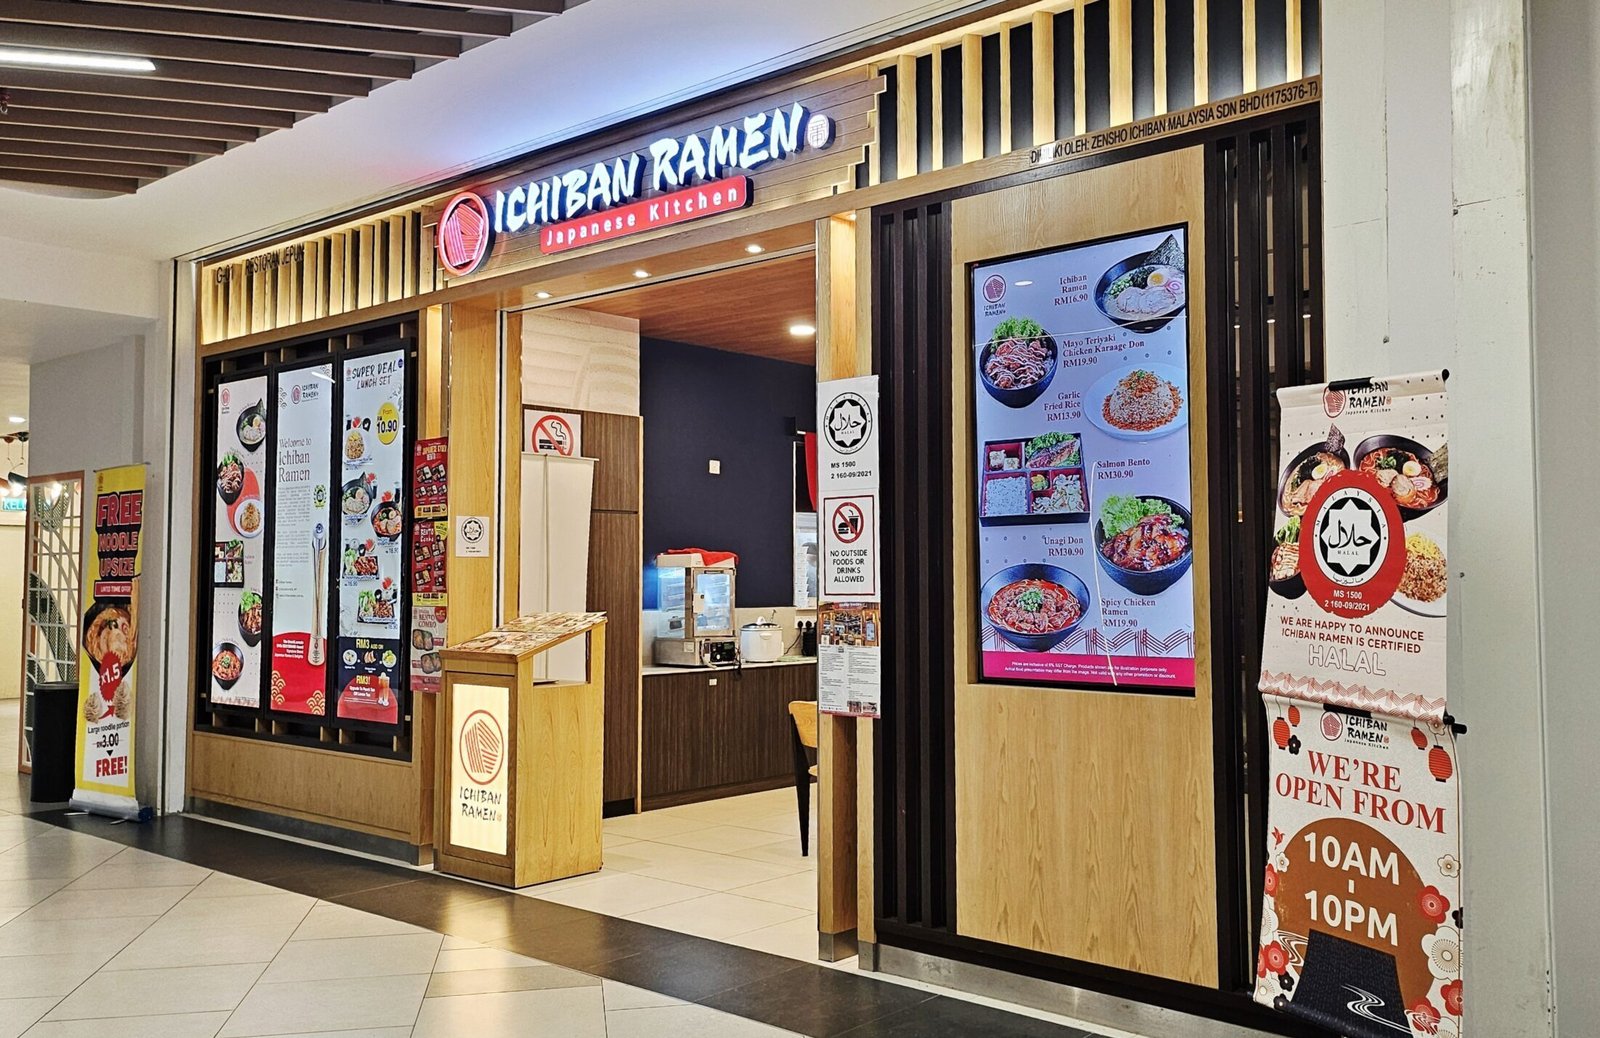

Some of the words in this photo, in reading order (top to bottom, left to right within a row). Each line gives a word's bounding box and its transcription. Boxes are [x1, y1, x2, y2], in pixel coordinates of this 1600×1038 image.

[1031, 143, 1062, 163] DIIKI
[1064, 138, 1090, 156] OLEH:
[1091, 128, 1128, 149] ZENSHO
[1130, 120, 1166, 140] ICHIBAN
[1168, 108, 1214, 130] MALAYSIA
[1216, 101, 1237, 118] SDN
[495, 152, 640, 233] ICHIBAN
[649, 101, 805, 191] RAMEN
[545, 211, 637, 246] Japanese
[649, 184, 738, 222] Kitchen
[1060, 275, 1087, 285] Ichiban
[1062, 284, 1088, 294] Ramen
[1054, 294, 1088, 306] RM16.90
[1062, 338, 1084, 348] Mayo
[1085, 334, 1116, 346] Teriyaki
[1062, 346, 1093, 357] Chicken
[1094, 343, 1128, 354] Karaage
[1128, 340, 1144, 349] Don
[1063, 356, 1098, 368] RM19.90
[352, 363, 376, 380] SUPER
[378, 360, 397, 376] DEAL
[356, 377, 378, 390] LUNCH
[380, 375, 392, 386] SET
[1058, 391, 1080, 400] Garlic
[1349, 396, 1386, 409] RAMEN
[1044, 402, 1063, 410] Fried
[1064, 400, 1080, 409] Rice
[834, 412, 862, 432] حلال
[1046, 410, 1082, 422] RM13.90
[376, 420, 398, 434] 10.90
[279, 438, 306, 448] Welcome
[306, 437, 312, 446] to
[278, 450, 310, 466] Ichiban
[842, 460, 856, 468] 1500
[1097, 460, 1127, 469] Salmon
[1128, 458, 1150, 467] Bento
[278, 468, 310, 482] Ramen
[1098, 470, 1134, 480] RM30.90
[97, 492, 142, 527] FREE
[1328, 519, 1372, 548] حلال
[98, 531, 138, 552] NOODLE
[1044, 536, 1066, 546] Unagi
[1067, 536, 1084, 544] Don
[841, 549, 868, 557] OUTSIDE
[1048, 546, 1084, 557] RM30.90
[100, 557, 134, 577] UPSIZE
[833, 558, 853, 566] FOODS
[1333, 590, 1344, 598] MS
[1101, 598, 1122, 608] Spicy
[1124, 598, 1156, 606] Chicken
[1330, 600, 1370, 611] 160-09/2021
[1102, 607, 1128, 616] Ramen
[1102, 618, 1138, 628] RM19.90
[1280, 616, 1294, 625] WE
[1295, 618, 1312, 628] ARE
[1315, 620, 1346, 632] HAPPY
[1349, 624, 1362, 634] TO
[1365, 626, 1424, 641] ANNOUNCE
[1282, 628, 1316, 640] ICHIBAN
[1318, 632, 1353, 644] RAMEN
[1356, 637, 1365, 646] IS
[1368, 639, 1421, 654] CERTIFIED
[1308, 643, 1387, 676] HALAL
[88, 725, 100, 734] Large
[1345, 715, 1387, 731] ICHIBAN
[1347, 728, 1384, 743] RAMEN
[96, 756, 128, 777] FREE!
[460, 786, 502, 805] ICHIBAN
[1276, 772, 1342, 810] OPEN
[1352, 789, 1446, 834] FROM
[461, 802, 496, 822] RAMEN
[1304, 831, 1400, 886] 10AM
[1304, 890, 1398, 947] 10PM
